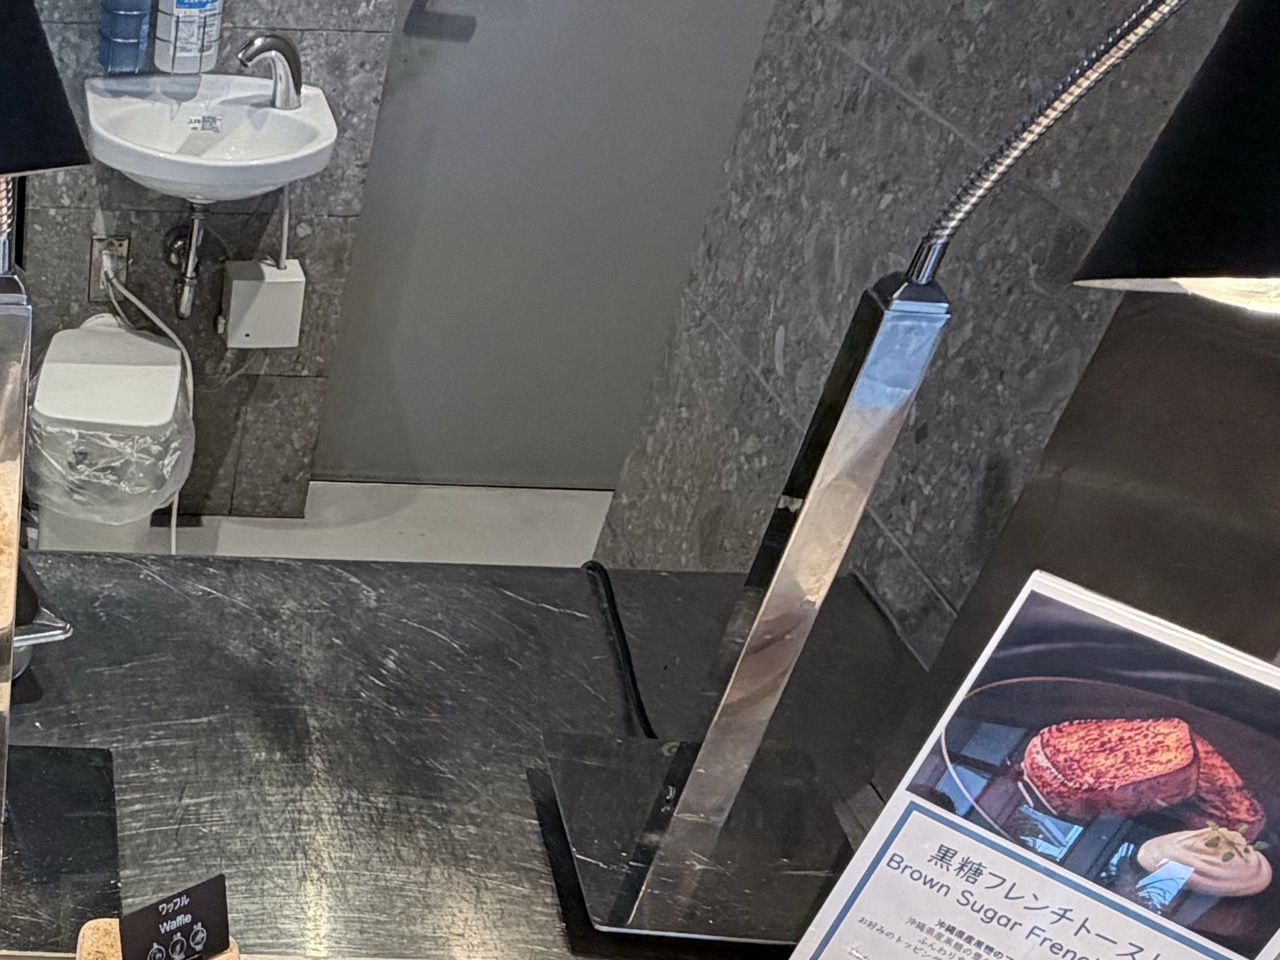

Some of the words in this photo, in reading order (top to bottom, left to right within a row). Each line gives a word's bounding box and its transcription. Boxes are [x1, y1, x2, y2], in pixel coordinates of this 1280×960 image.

[885, 852, 950, 897] Brown
[956, 889, 1022, 931] Sugar
[158, 894, 190, 915] ワッフル
[158, 913, 192, 934] Waffle
